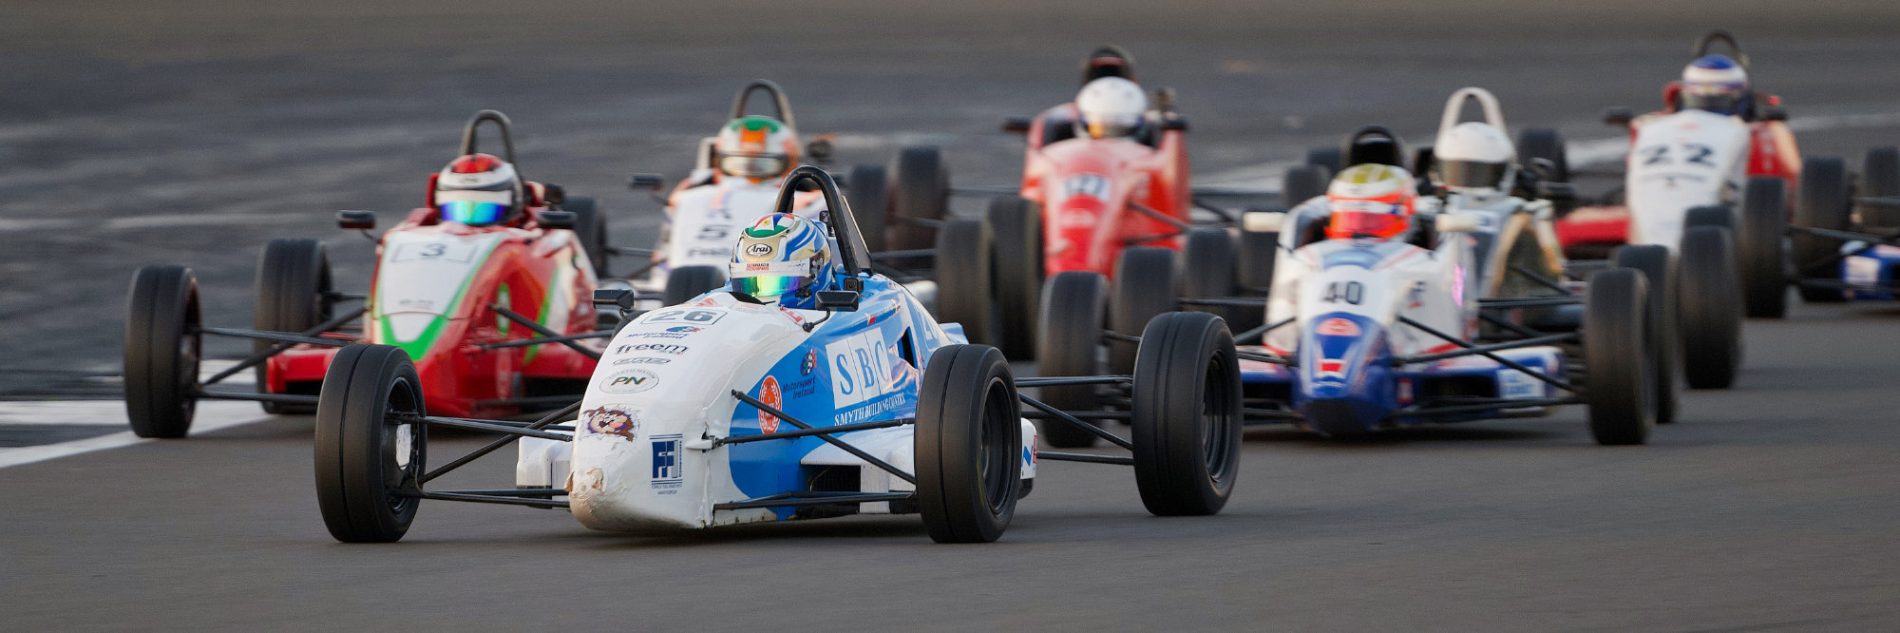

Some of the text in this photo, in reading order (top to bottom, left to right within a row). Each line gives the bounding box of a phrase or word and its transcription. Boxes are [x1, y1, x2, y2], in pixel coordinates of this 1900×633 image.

[1641, 144, 1716, 168] 22
[420, 243, 447, 257] 3
[751, 244, 770, 253] Arai
[1322, 281, 1364, 305] 40
[652, 310, 717, 322] 26
[614, 343, 688, 355] freem
[610, 376, 647, 386] PN
[834, 408, 864, 426] SMYTH
